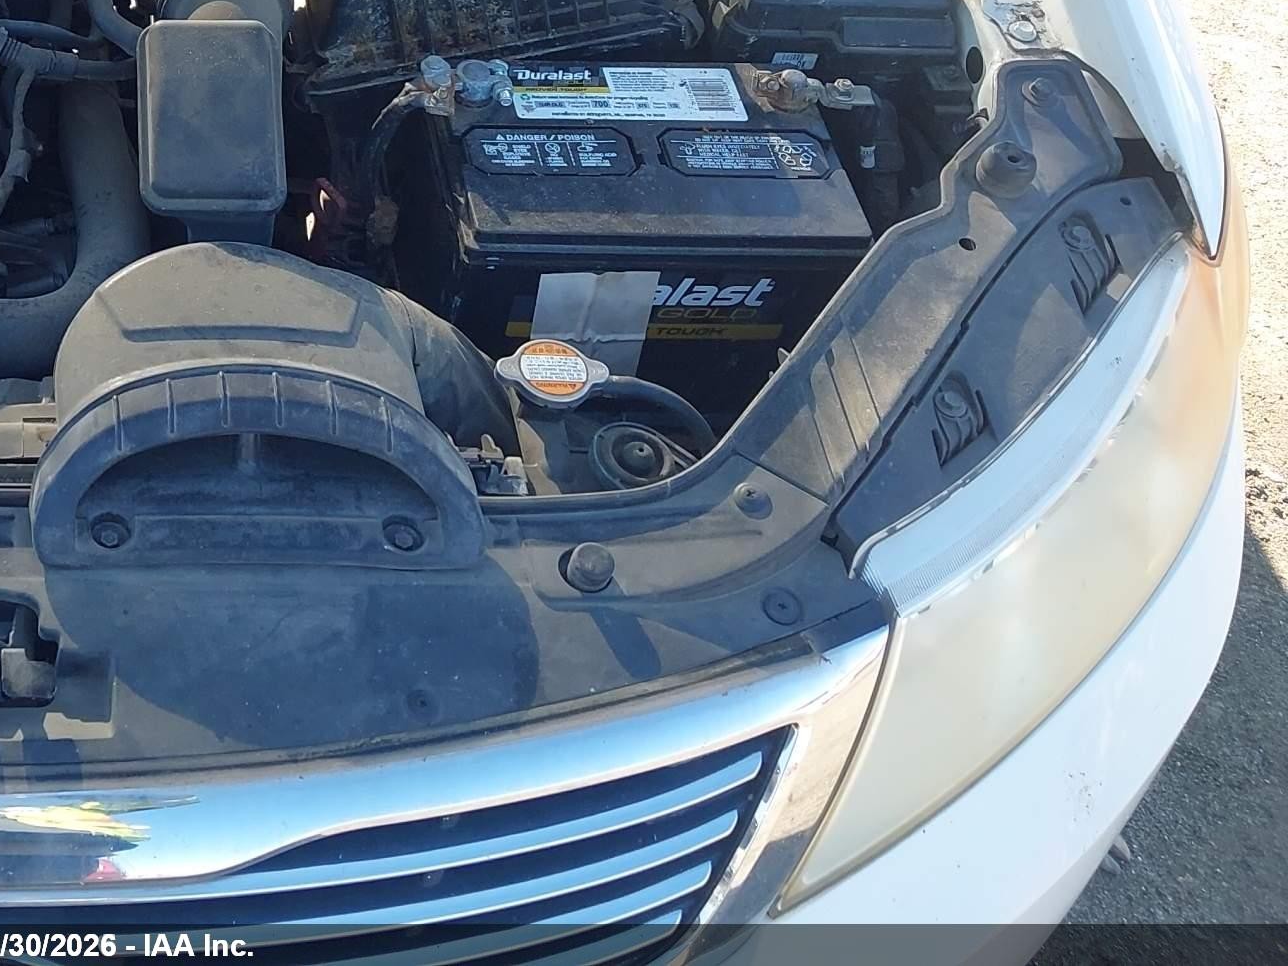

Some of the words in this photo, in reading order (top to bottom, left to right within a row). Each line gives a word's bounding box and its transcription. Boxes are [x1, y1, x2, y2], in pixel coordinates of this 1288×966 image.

[513, 69, 592, 81] Duralast
[592, 100, 609, 108] 700
[656, 308, 757, 319] GOLD
[656, 326, 726, 336] TOUGH
